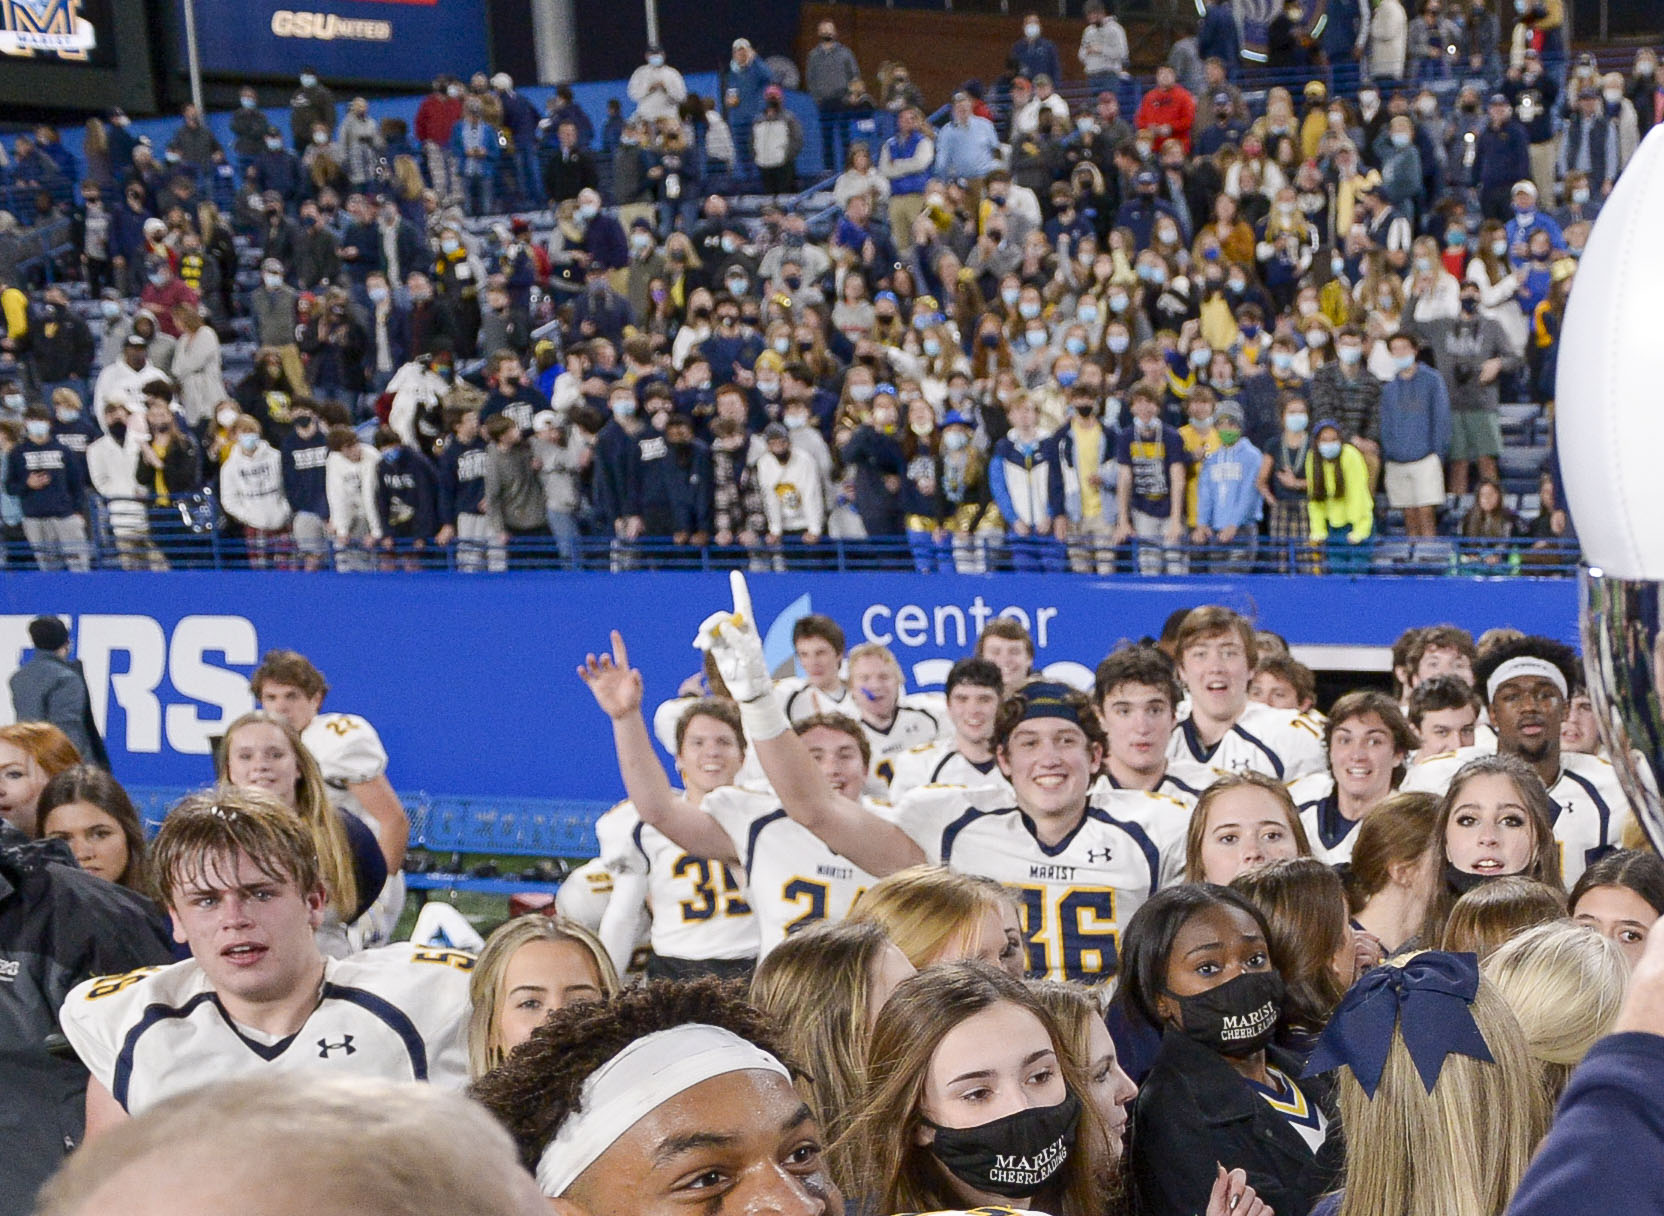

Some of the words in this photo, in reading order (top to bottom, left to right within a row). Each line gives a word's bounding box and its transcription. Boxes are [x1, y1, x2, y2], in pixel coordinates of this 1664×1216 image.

[1030, 865, 1076, 881] MARIST
[1222, 1001, 1274, 1030] MARIST
[989, 1145, 1067, 1185] CHEERLEADING
[994, 1134, 1064, 1171] MARIST
